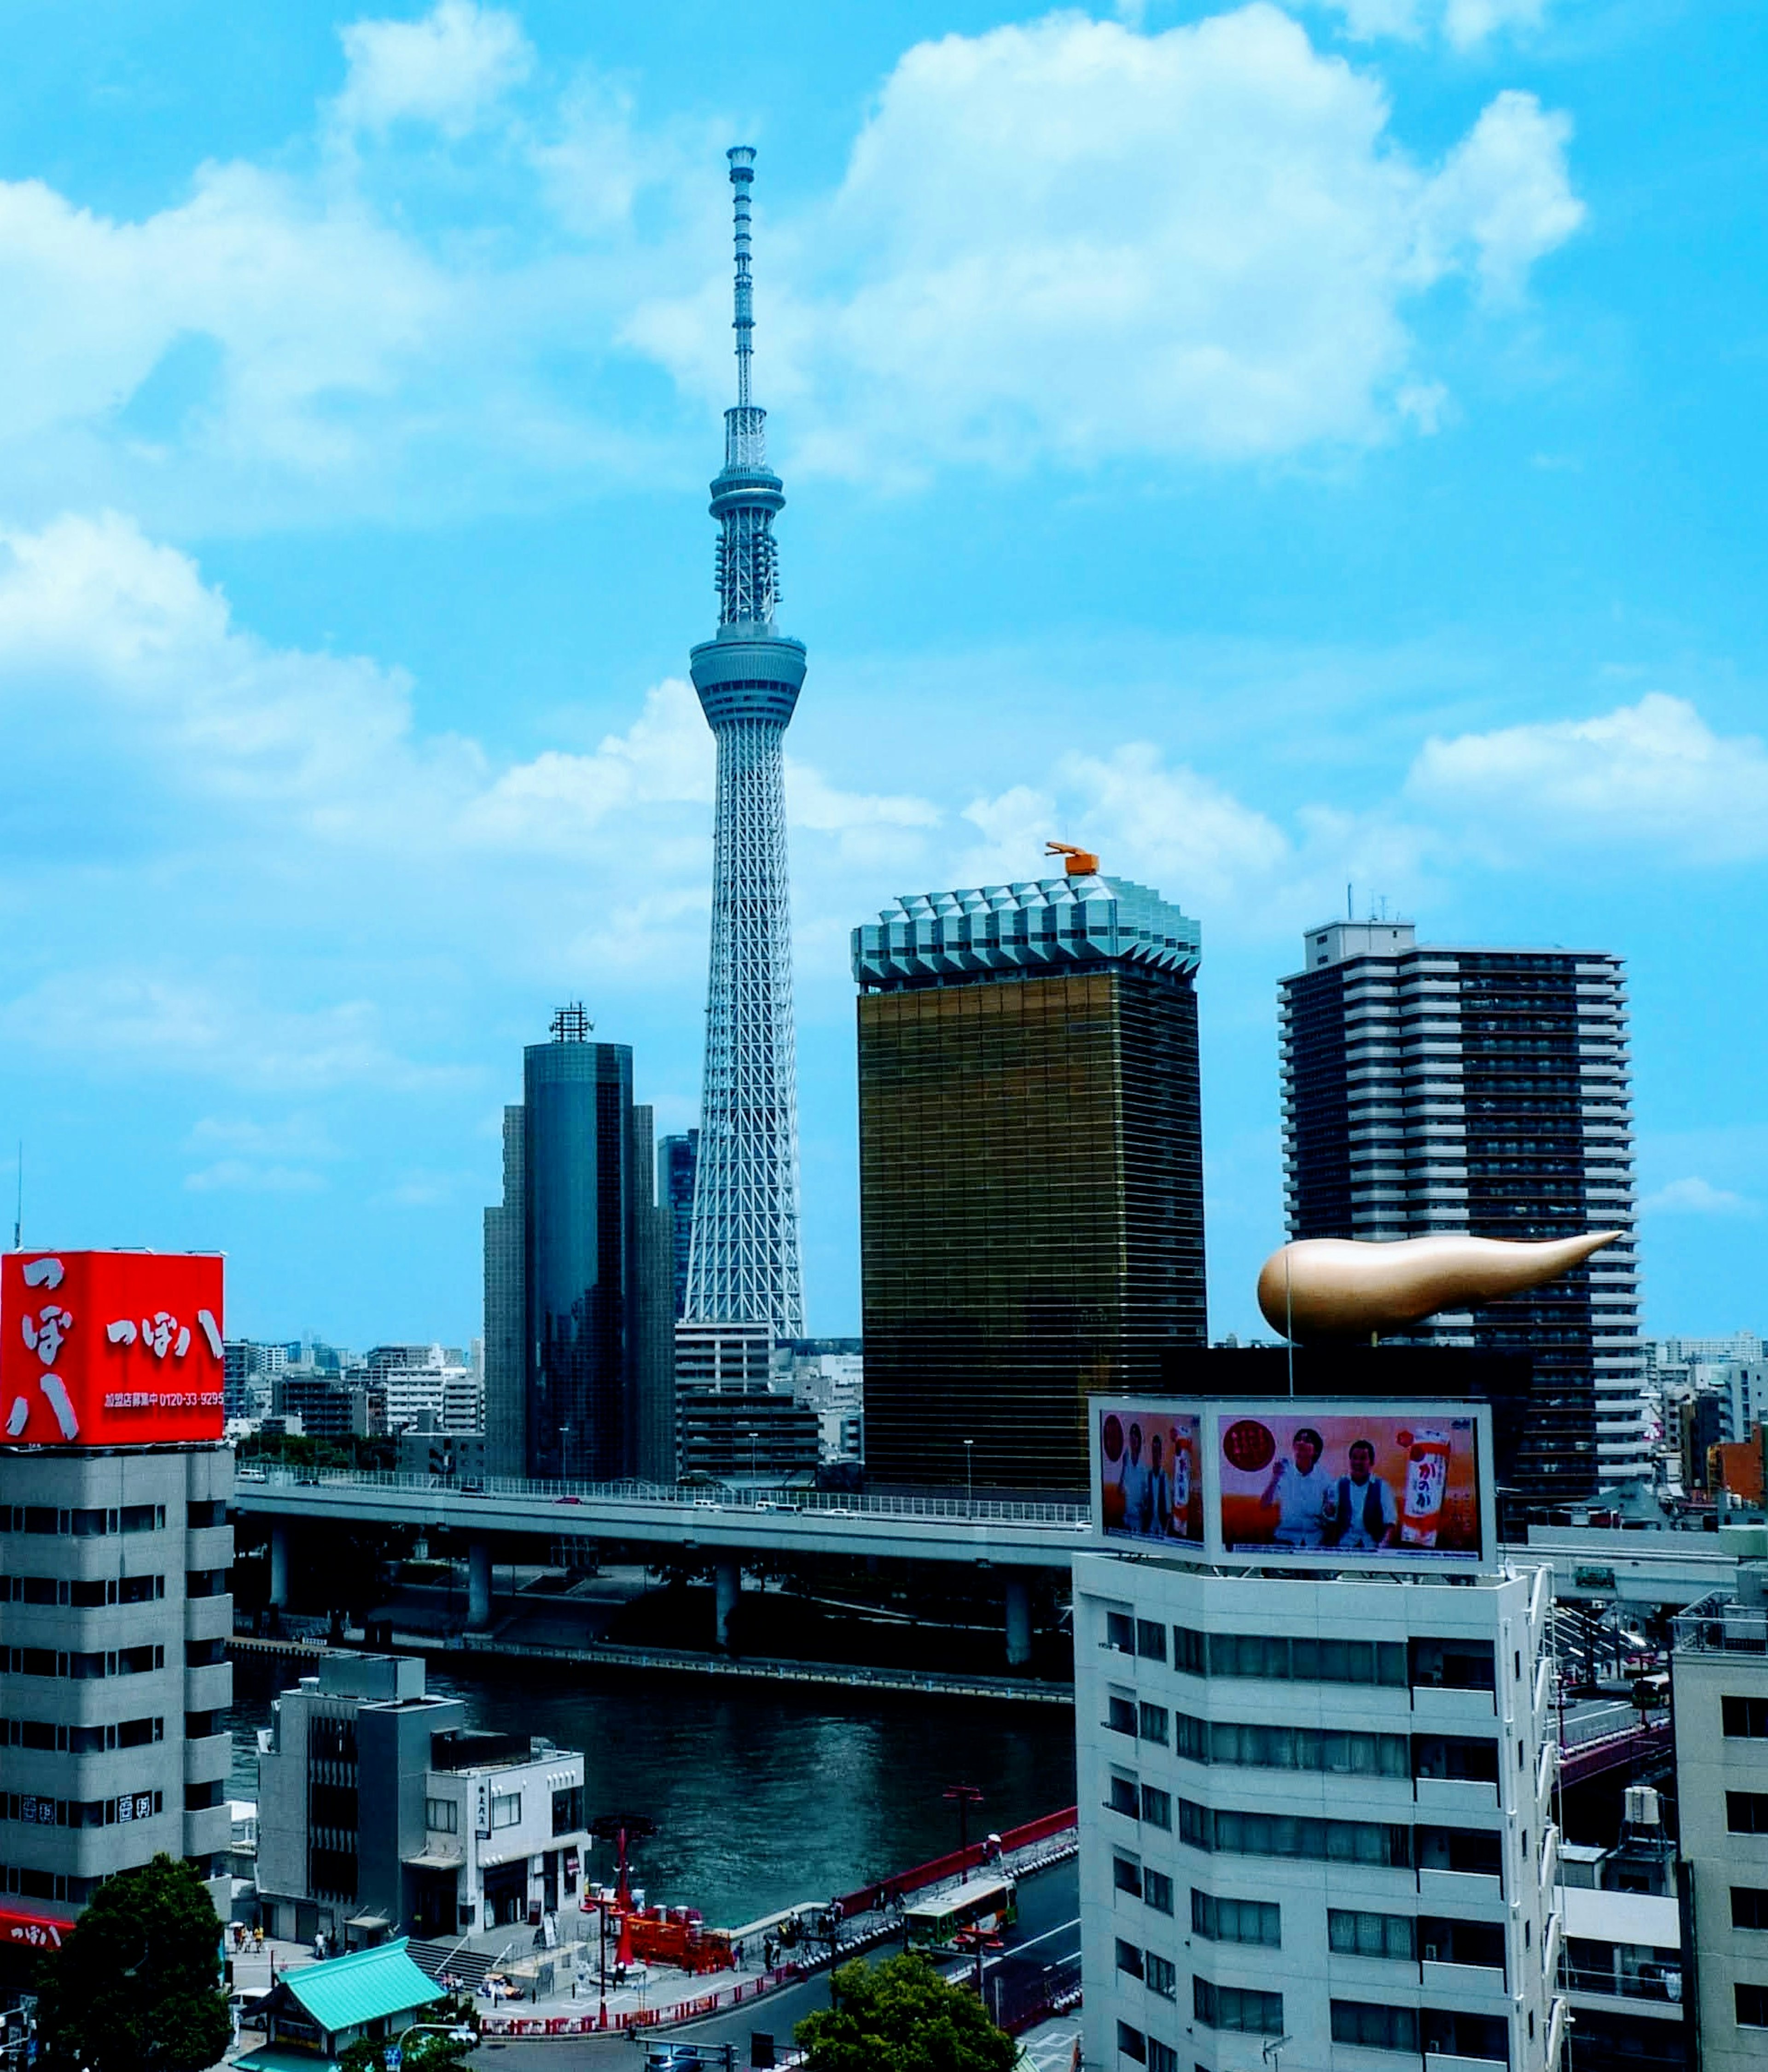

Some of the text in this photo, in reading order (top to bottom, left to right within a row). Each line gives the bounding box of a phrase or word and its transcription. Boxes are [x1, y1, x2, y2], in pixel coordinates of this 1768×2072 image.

[6, 1257, 80, 1440] つぼ八
[106, 1309, 224, 1359] つぼ八
[160, 1392, 224, 1406] 0120-33-9295
[11, 1925, 62, 1947] つぼ八
